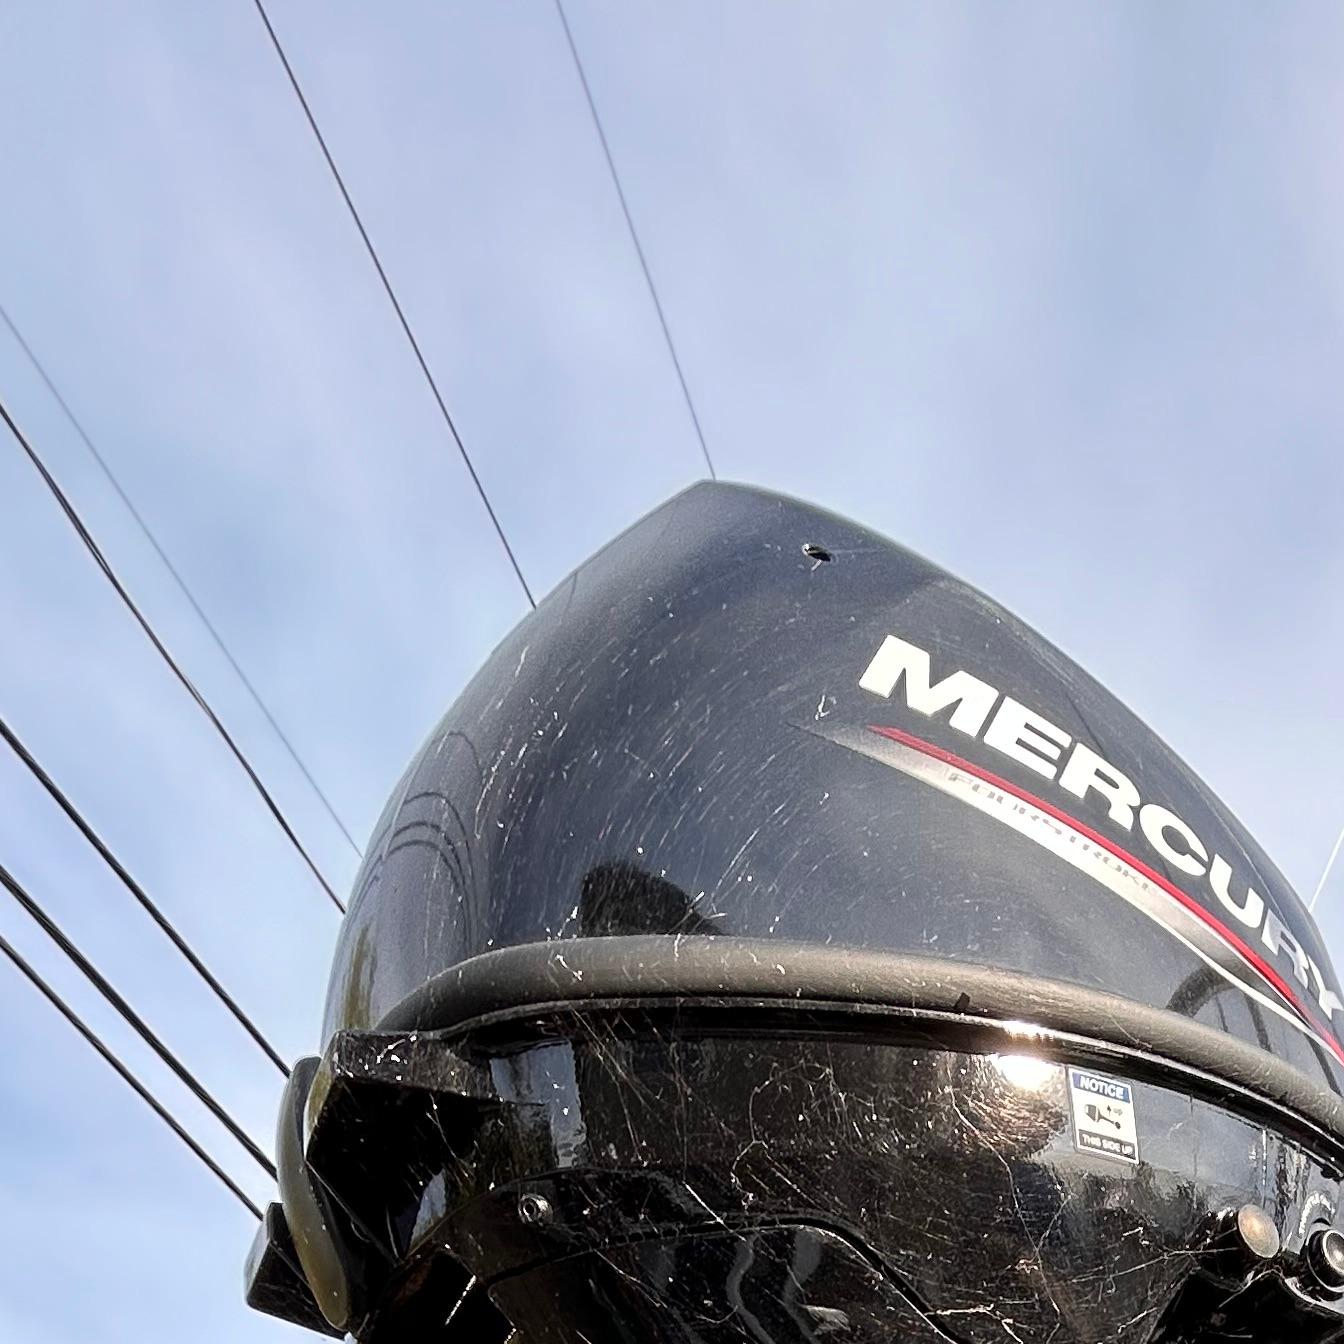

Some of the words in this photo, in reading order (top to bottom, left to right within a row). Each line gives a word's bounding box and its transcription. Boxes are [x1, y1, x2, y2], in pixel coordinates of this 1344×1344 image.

[858, 633, 1344, 1021] MERCURY
[1079, 1076, 1125, 1100] NOTICE
[1082, 1134, 1101, 1147] THIS
[1101, 1140, 1121, 1152] SIDE
